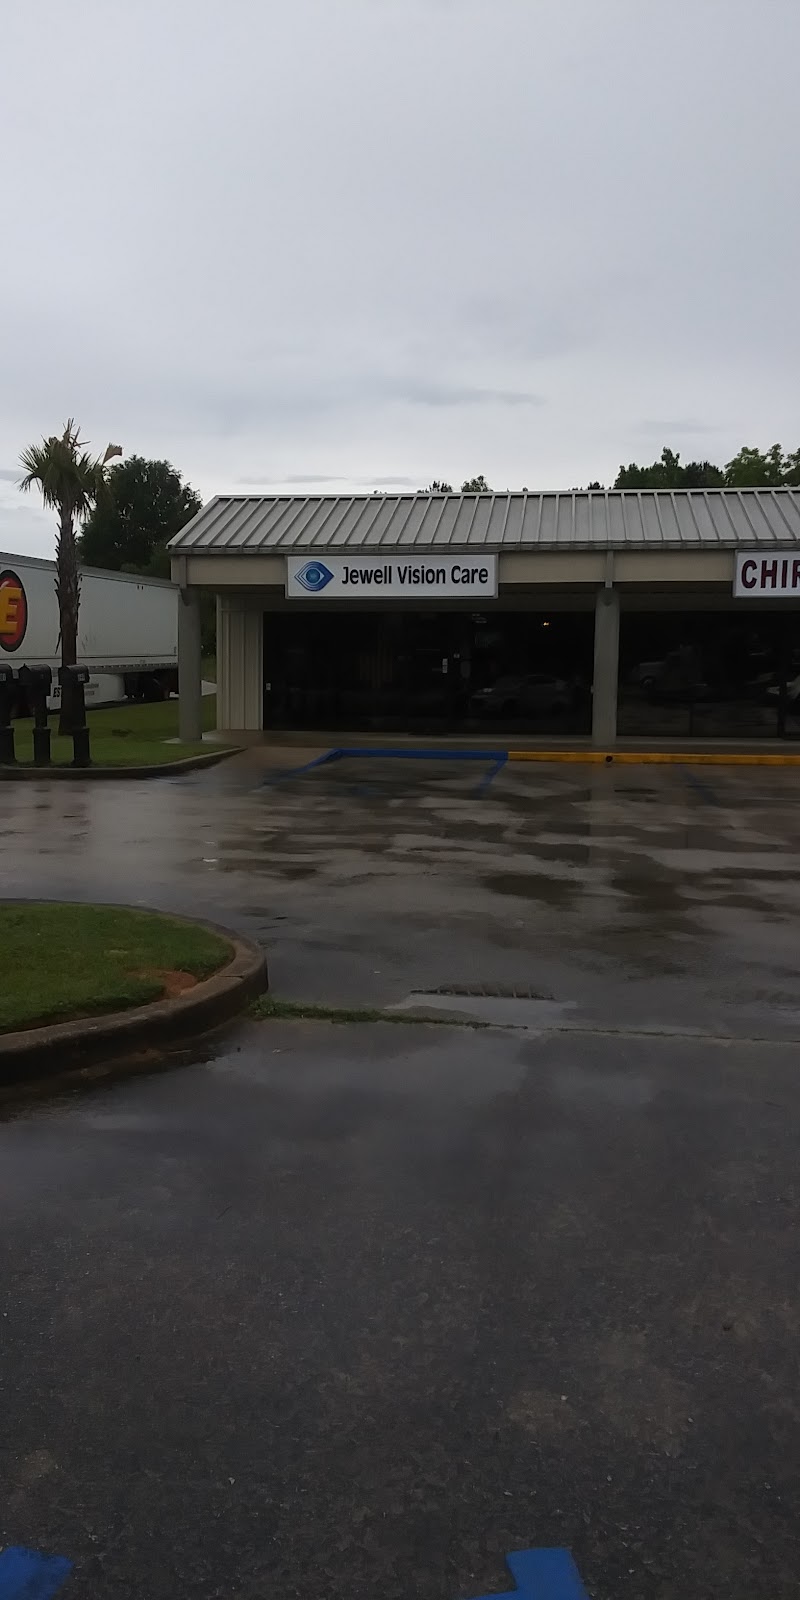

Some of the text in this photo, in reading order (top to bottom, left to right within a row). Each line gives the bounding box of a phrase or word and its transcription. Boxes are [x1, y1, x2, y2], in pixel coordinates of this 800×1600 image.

[341, 565, 489, 585] Jewell Vision Care
